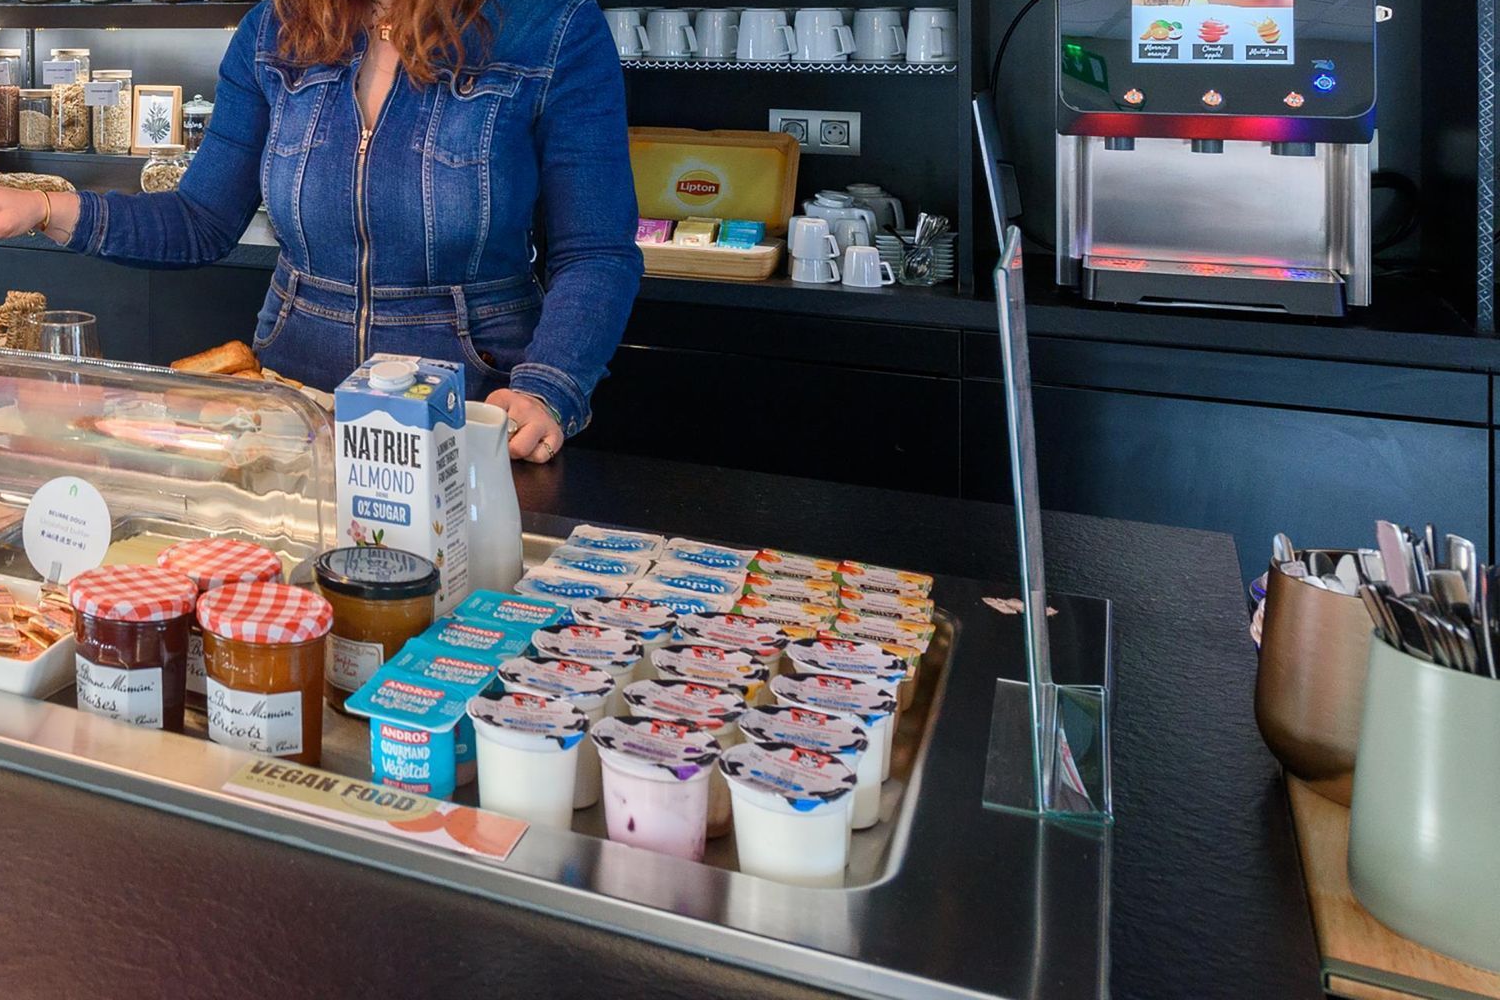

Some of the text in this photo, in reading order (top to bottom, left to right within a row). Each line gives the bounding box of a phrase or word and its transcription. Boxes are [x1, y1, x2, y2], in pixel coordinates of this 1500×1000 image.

[680, 182, 716, 192] Lipton
[343, 424, 422, 469] NATRUE
[348, 463, 414, 495] ALMOND
[357, 500, 406, 523] 0% SUGAR
[107, 675, 153, 693] Maman
[385, 681, 444, 698] ANDROS
[245, 699, 295, 719] Maman
[382, 726, 429, 743] ANDROS
[381, 739, 431, 760] GOURMAND
[250, 760, 341, 793] VEGAN
[341, 783, 416, 811] FOOD
